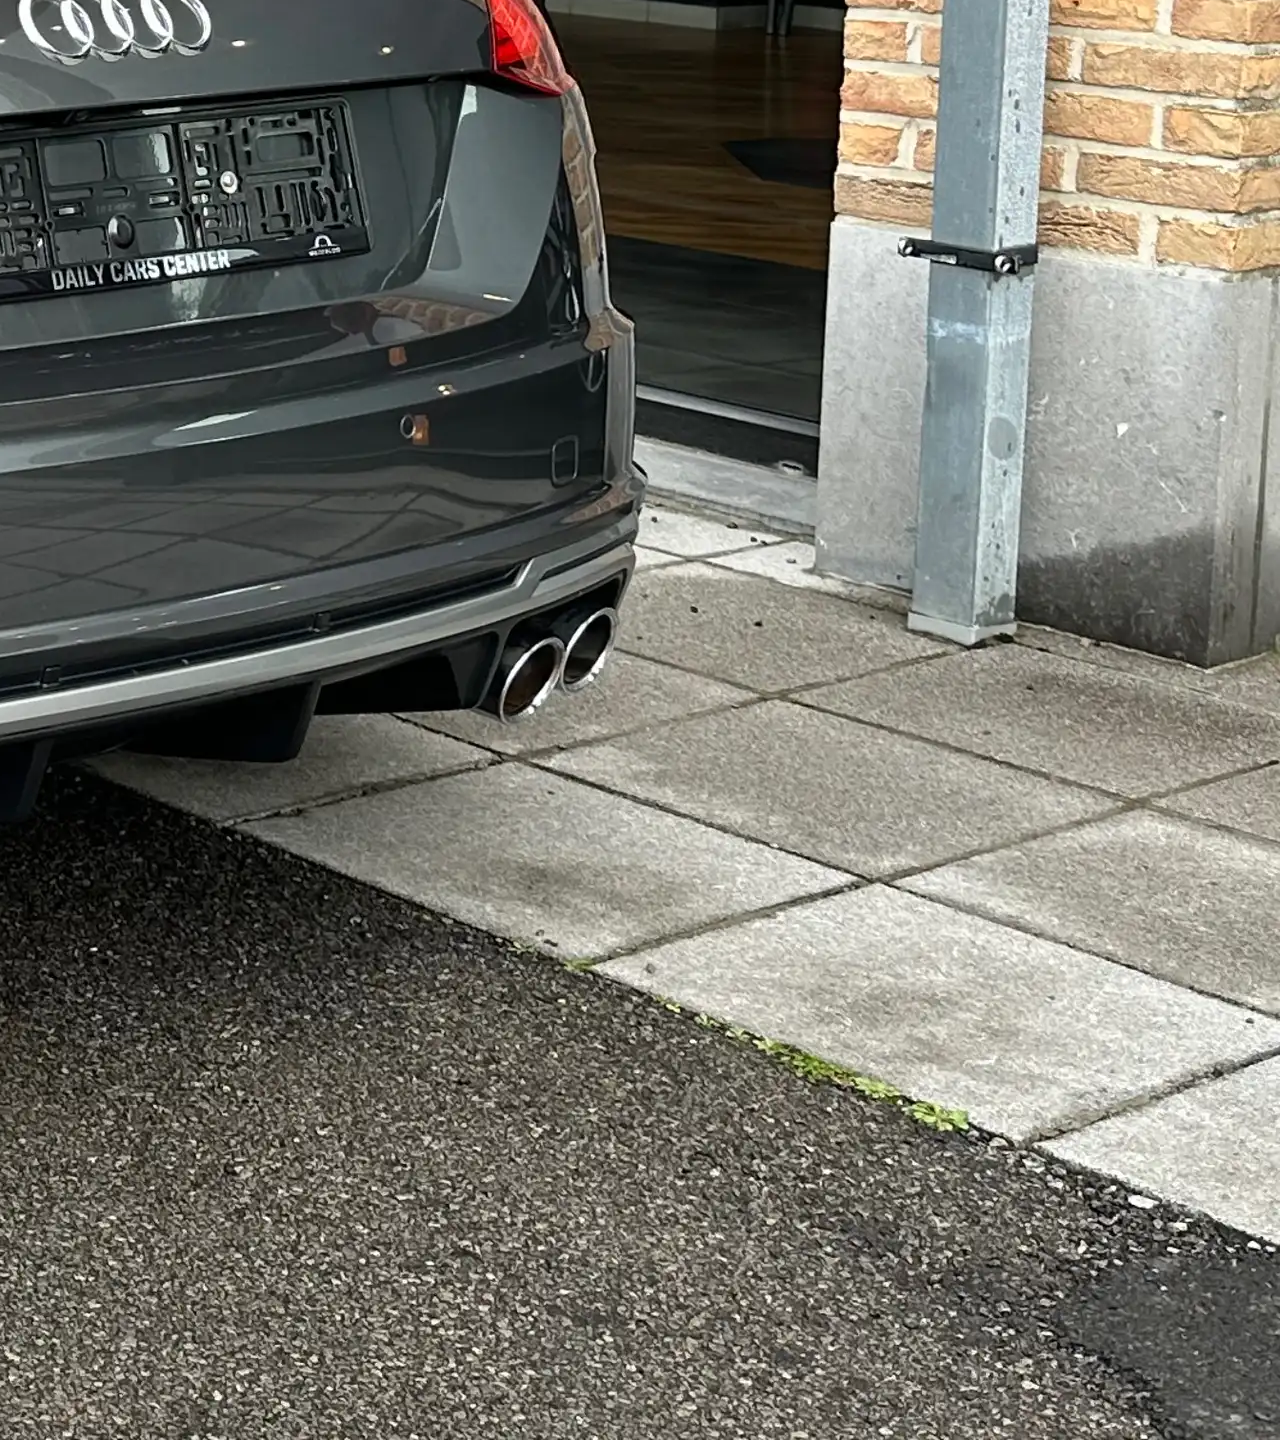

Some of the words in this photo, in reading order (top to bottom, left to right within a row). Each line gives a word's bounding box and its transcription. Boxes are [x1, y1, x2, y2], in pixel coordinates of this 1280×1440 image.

[51, 263, 105, 291] DAILY
[109, 258, 160, 283] CARS
[163, 249, 231, 277] CENTER
